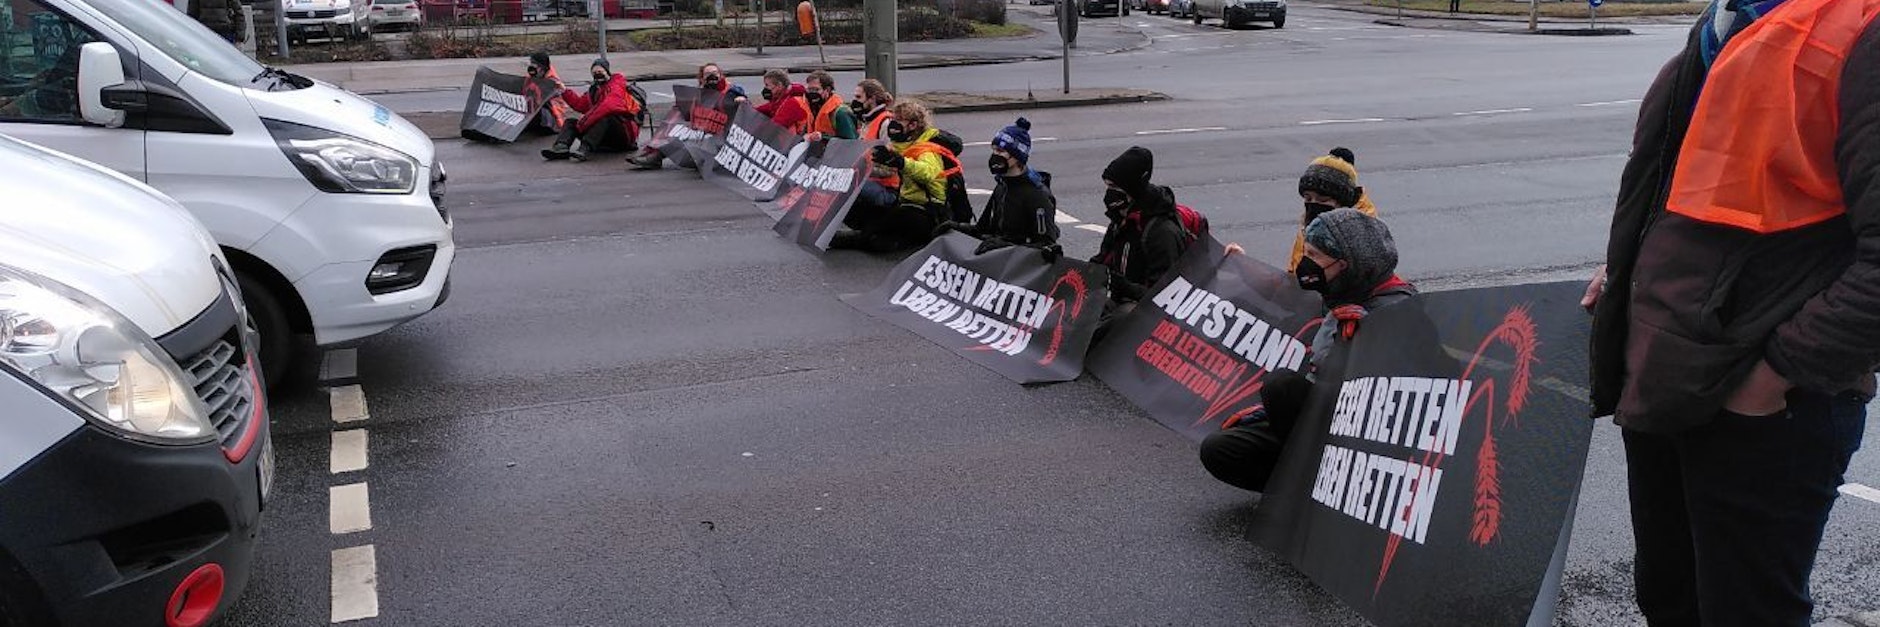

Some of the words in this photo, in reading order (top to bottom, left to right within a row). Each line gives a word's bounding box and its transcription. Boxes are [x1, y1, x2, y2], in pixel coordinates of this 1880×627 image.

[889, 280, 962, 323] LEBEN
[944, 308, 1033, 357] RETTEN
[914, 254, 981, 304] ESSEN
[972, 276, 1055, 330] RETTEN
[1151, 275, 1307, 373] AUFSTAND
[1135, 337, 1223, 401] GENERATION
[1151, 318, 1181, 346] DER
[1174, 331, 1239, 381] LETZTEN
[1328, 376, 1376, 438] ESSEN
[1363, 376, 1473, 456] RETTEN
[1343, 450, 1443, 546] RETTEN
